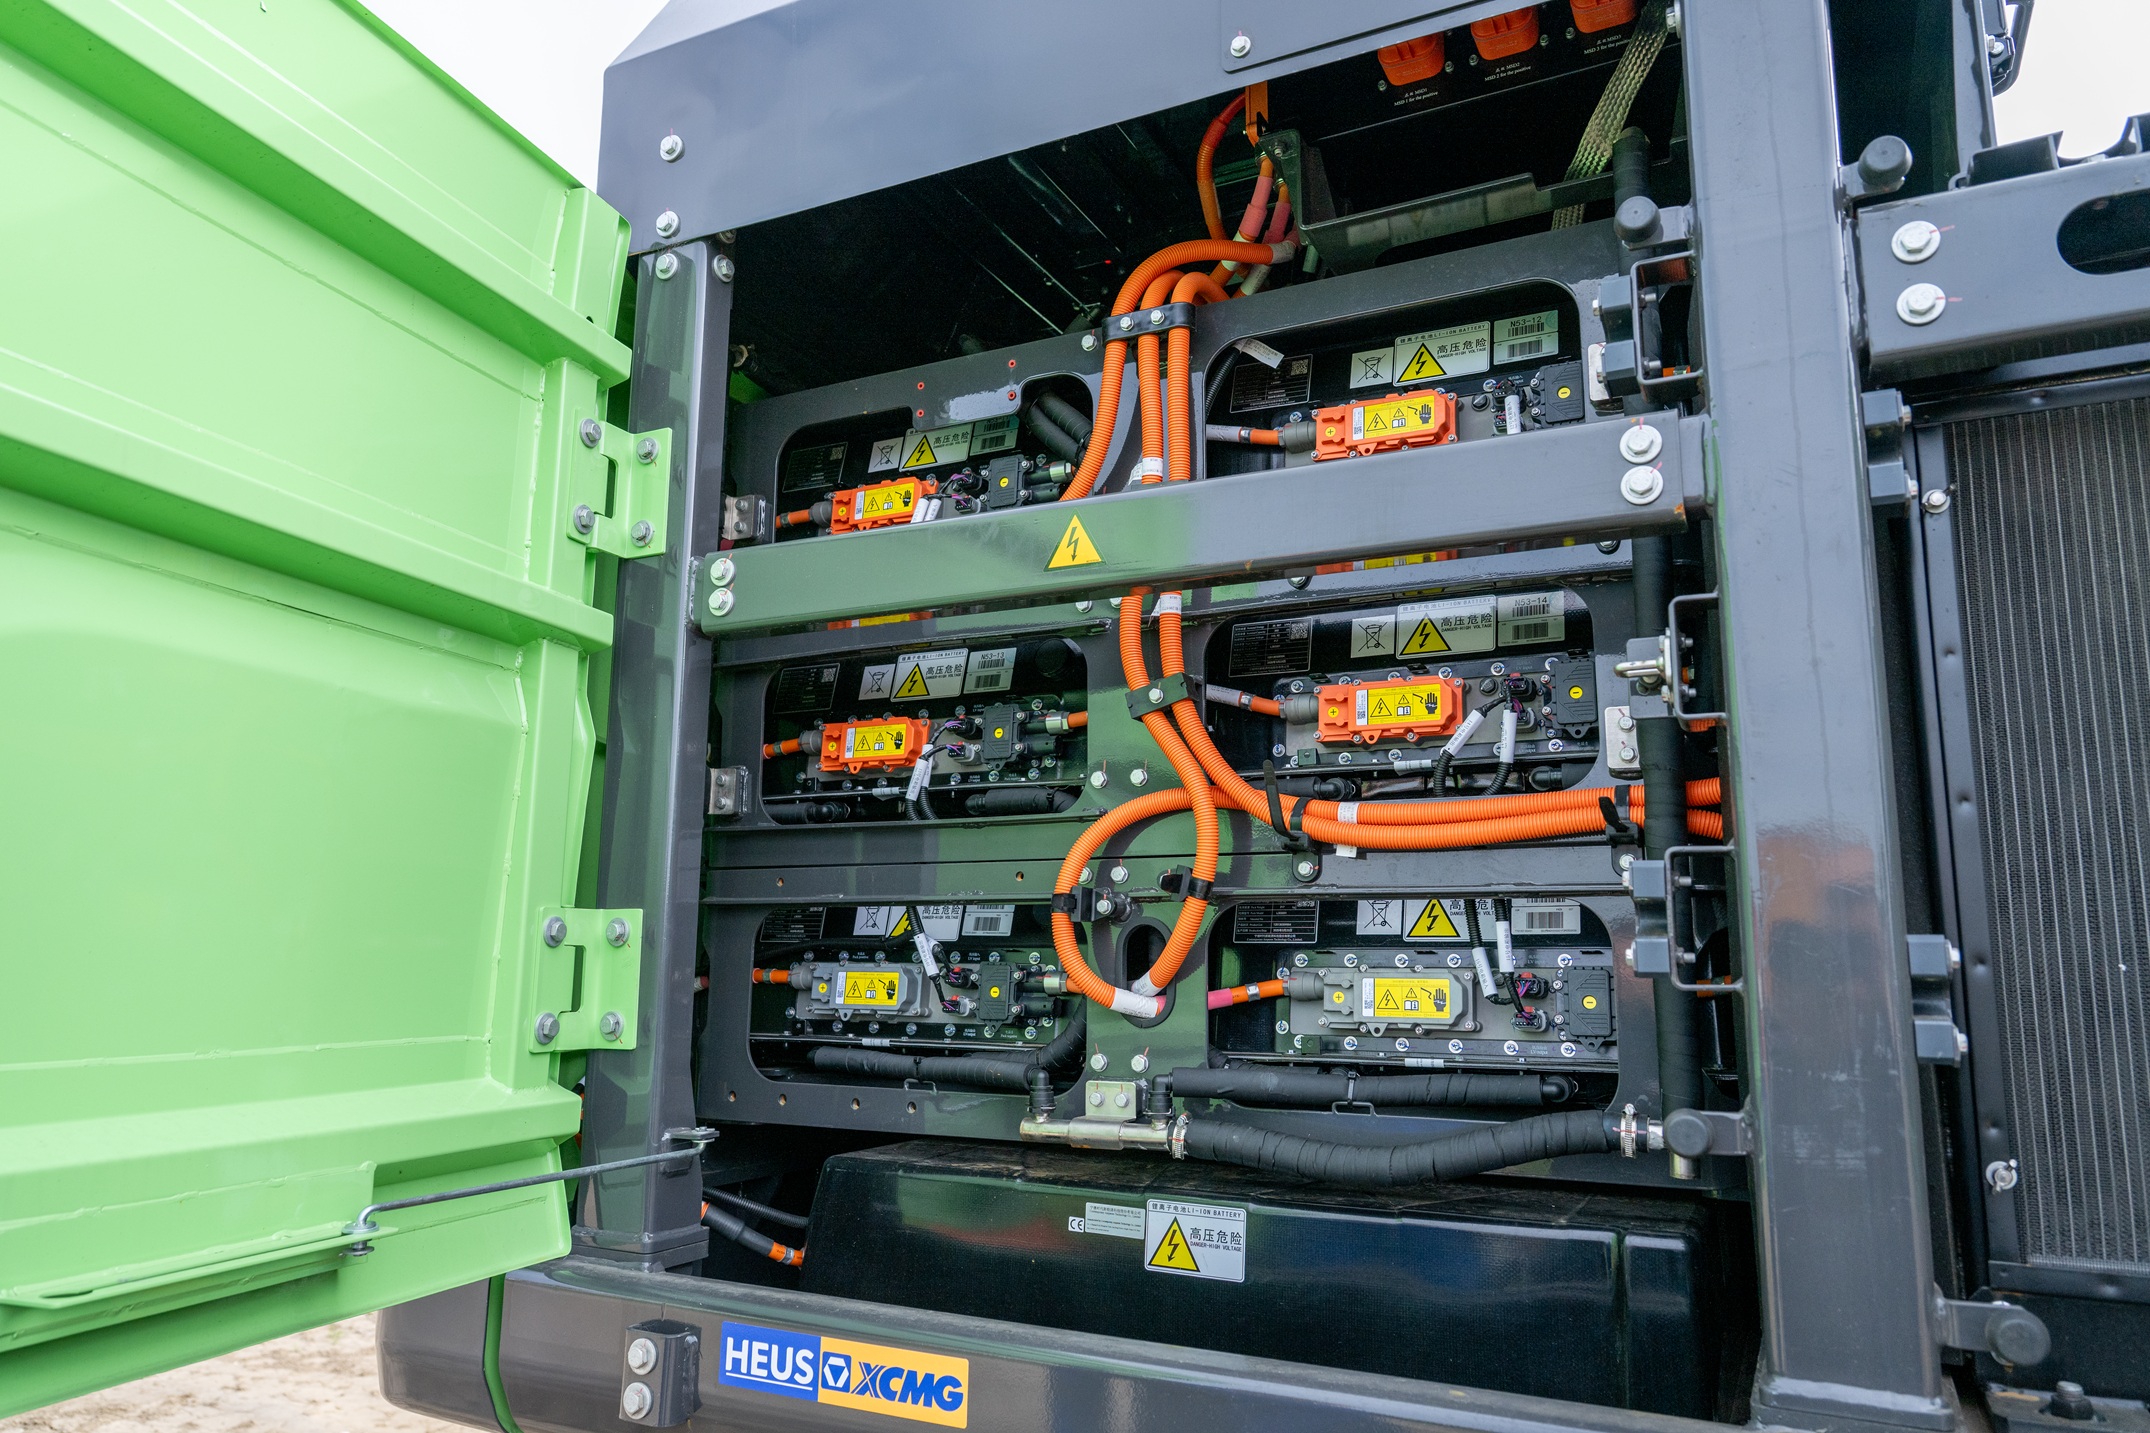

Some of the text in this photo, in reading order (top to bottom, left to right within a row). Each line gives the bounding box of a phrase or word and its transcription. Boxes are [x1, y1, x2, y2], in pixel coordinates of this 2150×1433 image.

[1511, 316, 1541, 327] N53-12
[1459, 324, 1485, 333] BATTERY
[1437, 338, 1487, 355] 高压危险
[1437, 351, 1466, 359] DANGER-HIGH
[933, 431, 970, 445] 高压危险
[1515, 597, 1547, 606] N53-14
[1441, 613, 1492, 627] 高压危险
[981, 652, 1004, 660] N53-13
[926, 664, 963, 675] 高压危险
[922, 906, 960, 915] 高压危险
[1214, 1210, 1241, 1218] BATTERY
[1070, 1219, 1083, 1231] CE
[1190, 1227, 1242, 1246] 高压危险
[1190, 1241, 1220, 1249] DANGER-HIGH
[725, 1336, 963, 1412] HEUS XCMG
